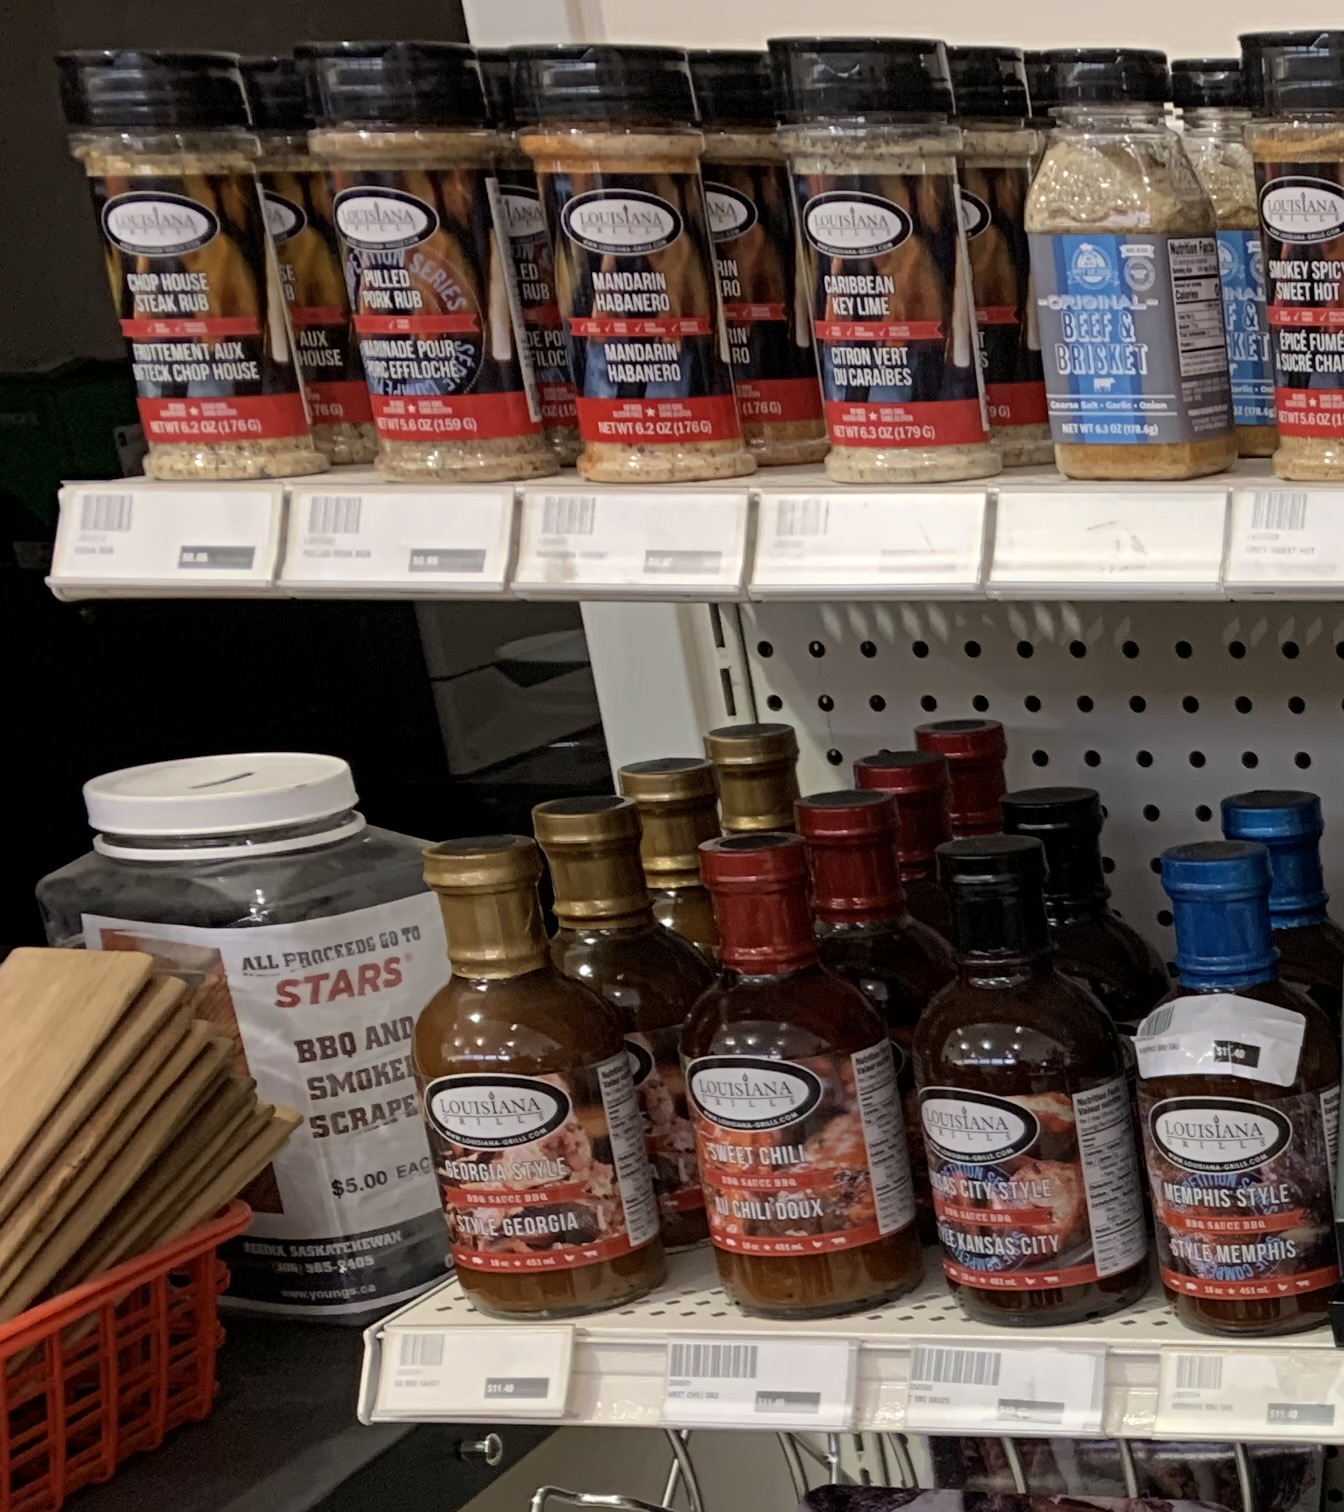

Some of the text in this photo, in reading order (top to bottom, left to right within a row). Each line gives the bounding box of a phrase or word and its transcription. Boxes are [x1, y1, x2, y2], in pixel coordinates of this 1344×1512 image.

[364, 271, 410, 287] PULLED
[1269, 261, 1309, 279] SMOKEY
[128, 273, 209, 291] CHOP HOUSE
[593, 272, 666, 291] MANDARIN
[824, 276, 894, 294] CARIBBEAN
[363, 291, 422, 308] PORK RUB
[1276, 283, 1339, 301] SWEET HOT
[136, 295, 209, 311] STEAK RUB
[596, 293, 670, 312] HABANERO
[832, 297, 890, 315] KEY LIME
[1063, 311, 1136, 341] BEEF &
[1055, 343, 1148, 374] BRISKET
[242, 926, 420, 972] ALL PROCEEDS GO TO
[275, 957, 403, 1009] STARS
[294, 1016, 415, 1064] BBQ AND
[709, 1145, 806, 1166] SWEET CHILI
[444, 1158, 568, 1181] GEORGIA STYLE
[331, 1171, 388, 1198] $5.00
[1164, 1183, 1289, 1208] MEMPHIS STYLE
